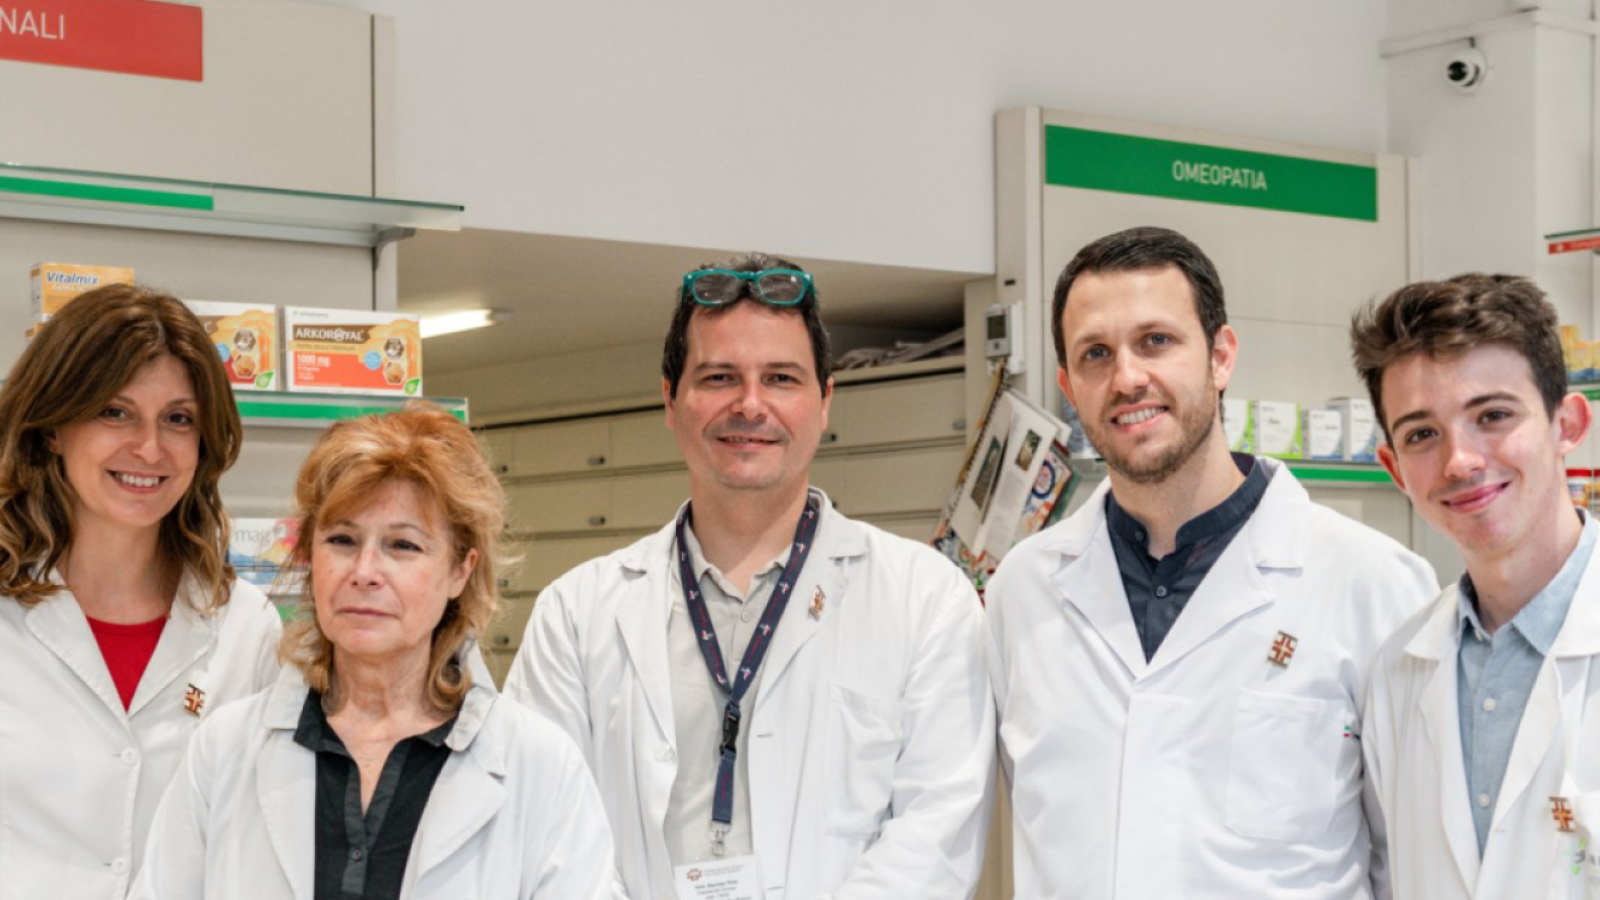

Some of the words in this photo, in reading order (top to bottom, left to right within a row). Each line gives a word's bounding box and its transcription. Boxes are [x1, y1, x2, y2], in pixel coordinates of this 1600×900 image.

[0, 6, 65, 41] NALI
[1172, 160, 1268, 191] OMEOPATIA
[46, 271, 98, 285] Vitalmix
